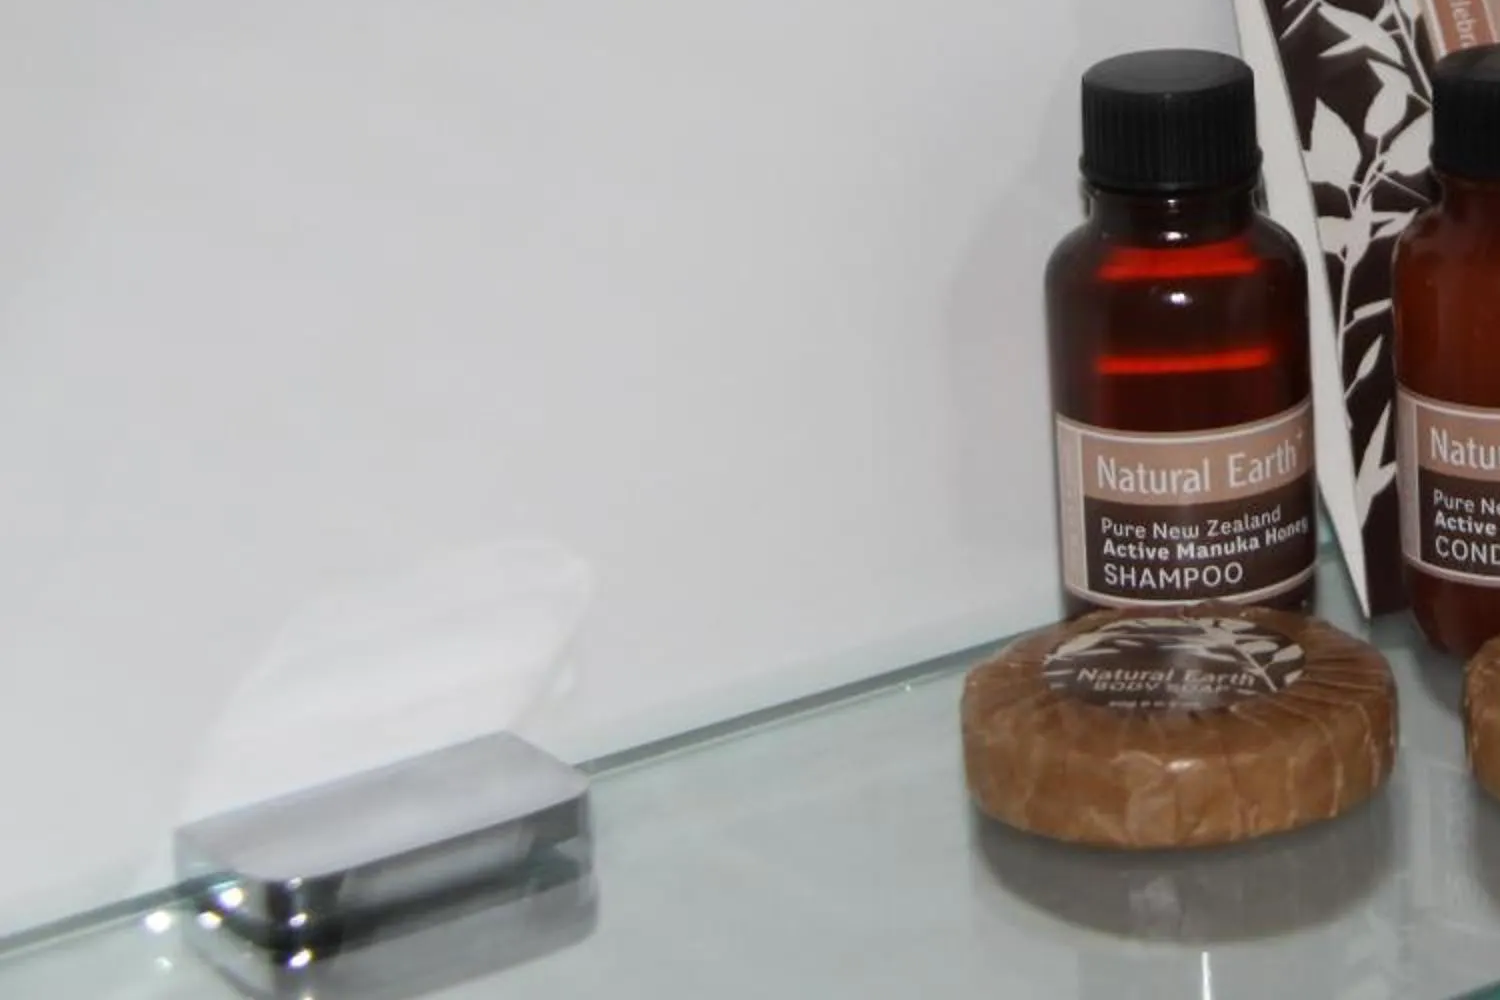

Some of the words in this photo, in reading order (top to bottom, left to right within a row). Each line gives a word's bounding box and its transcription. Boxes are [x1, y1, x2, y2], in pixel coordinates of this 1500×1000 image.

[1096, 454, 1211, 495] Natural
[1433, 487, 1475, 513] Pure
[1101, 516, 1147, 540] Pure
[1153, 522, 1200, 540] New
[1206, 504, 1282, 537] Zealand
[1434, 511, 1497, 536] Active
[1103, 539, 1171, 561] Active
[1176, 536, 1261, 562] Manuka
[1265, 516, 1310, 546] Honey
[1104, 561, 1244, 589] SHAMPOO
[1077, 667, 1175, 682] Natural
[1184, 669, 1256, 686] Earth
[1093, 681, 1161, 692] BODY
